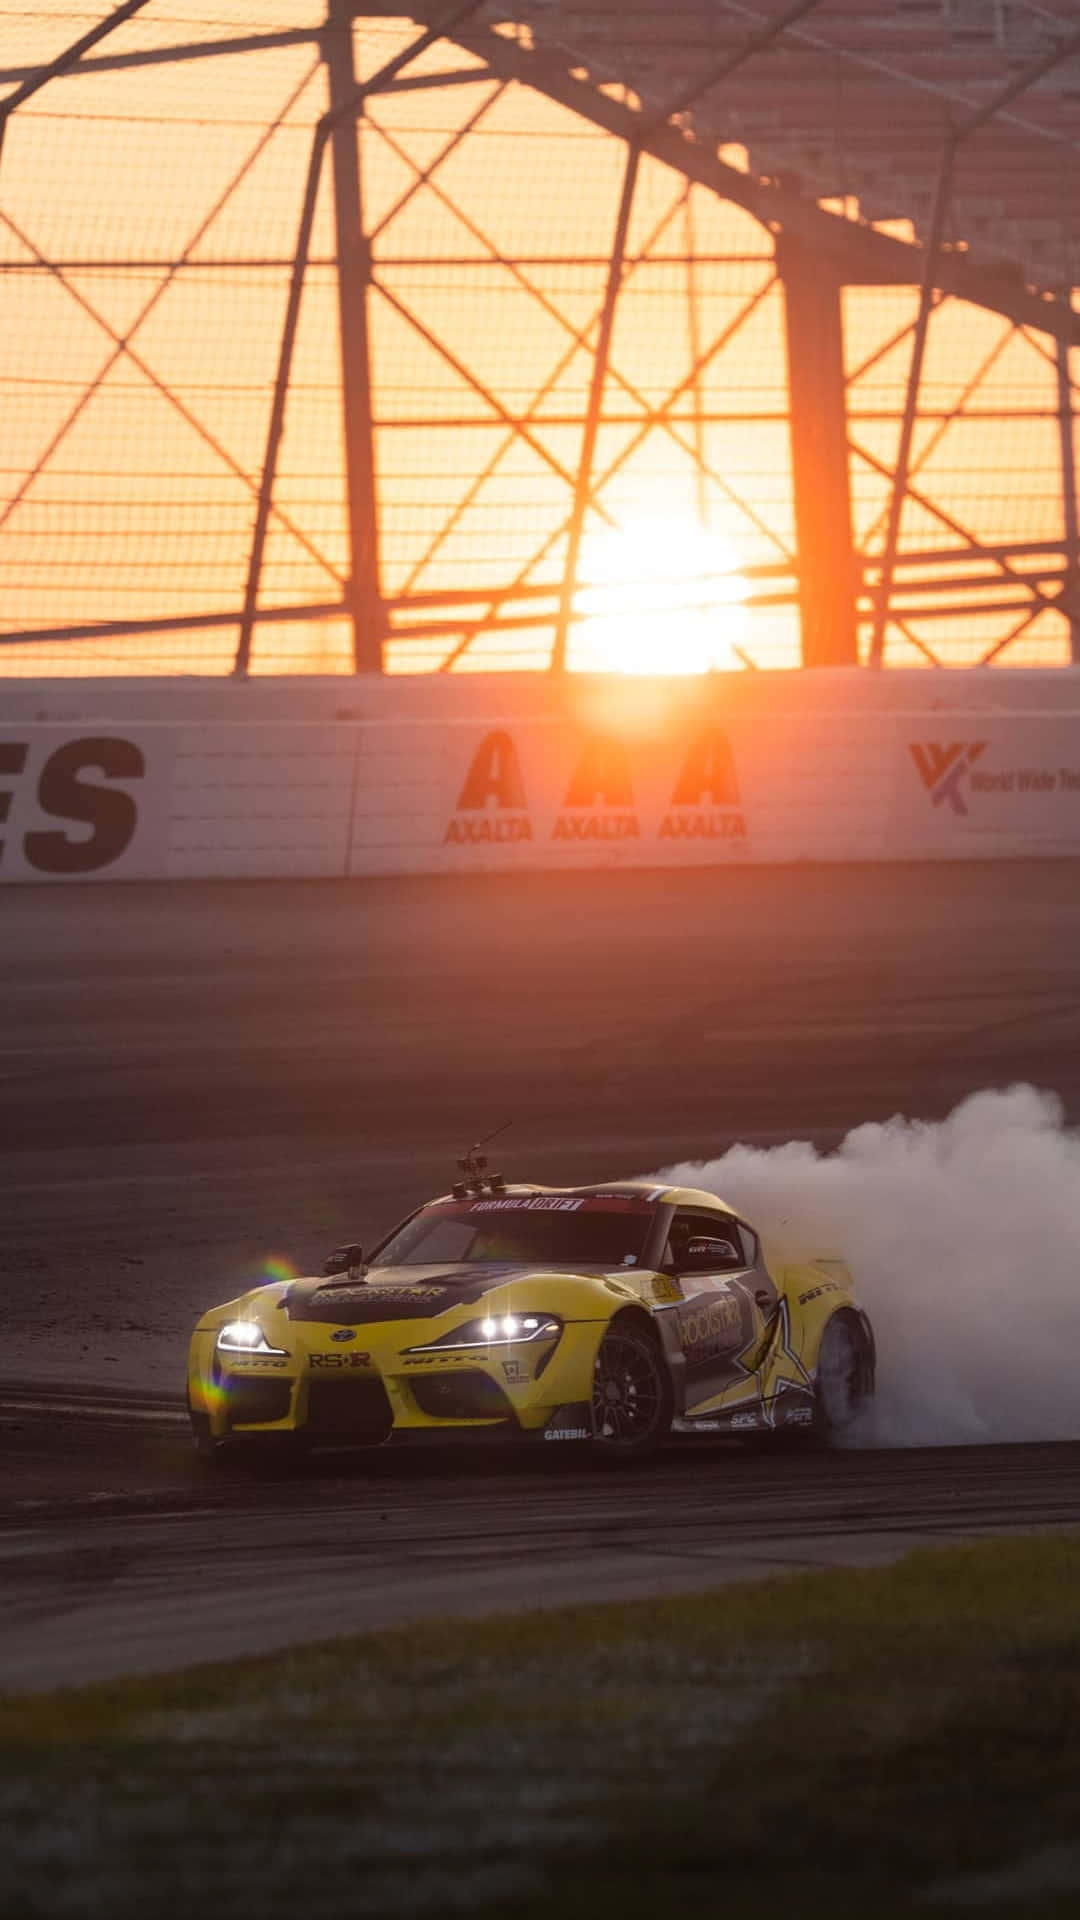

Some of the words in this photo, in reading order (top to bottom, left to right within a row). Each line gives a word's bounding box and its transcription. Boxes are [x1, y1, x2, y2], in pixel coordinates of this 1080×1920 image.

[0, 736, 147, 874] S
[443, 815, 533, 845] AXALTA
[551, 813, 640, 841] AXALTA
[657, 812, 748, 840] AXALTA
